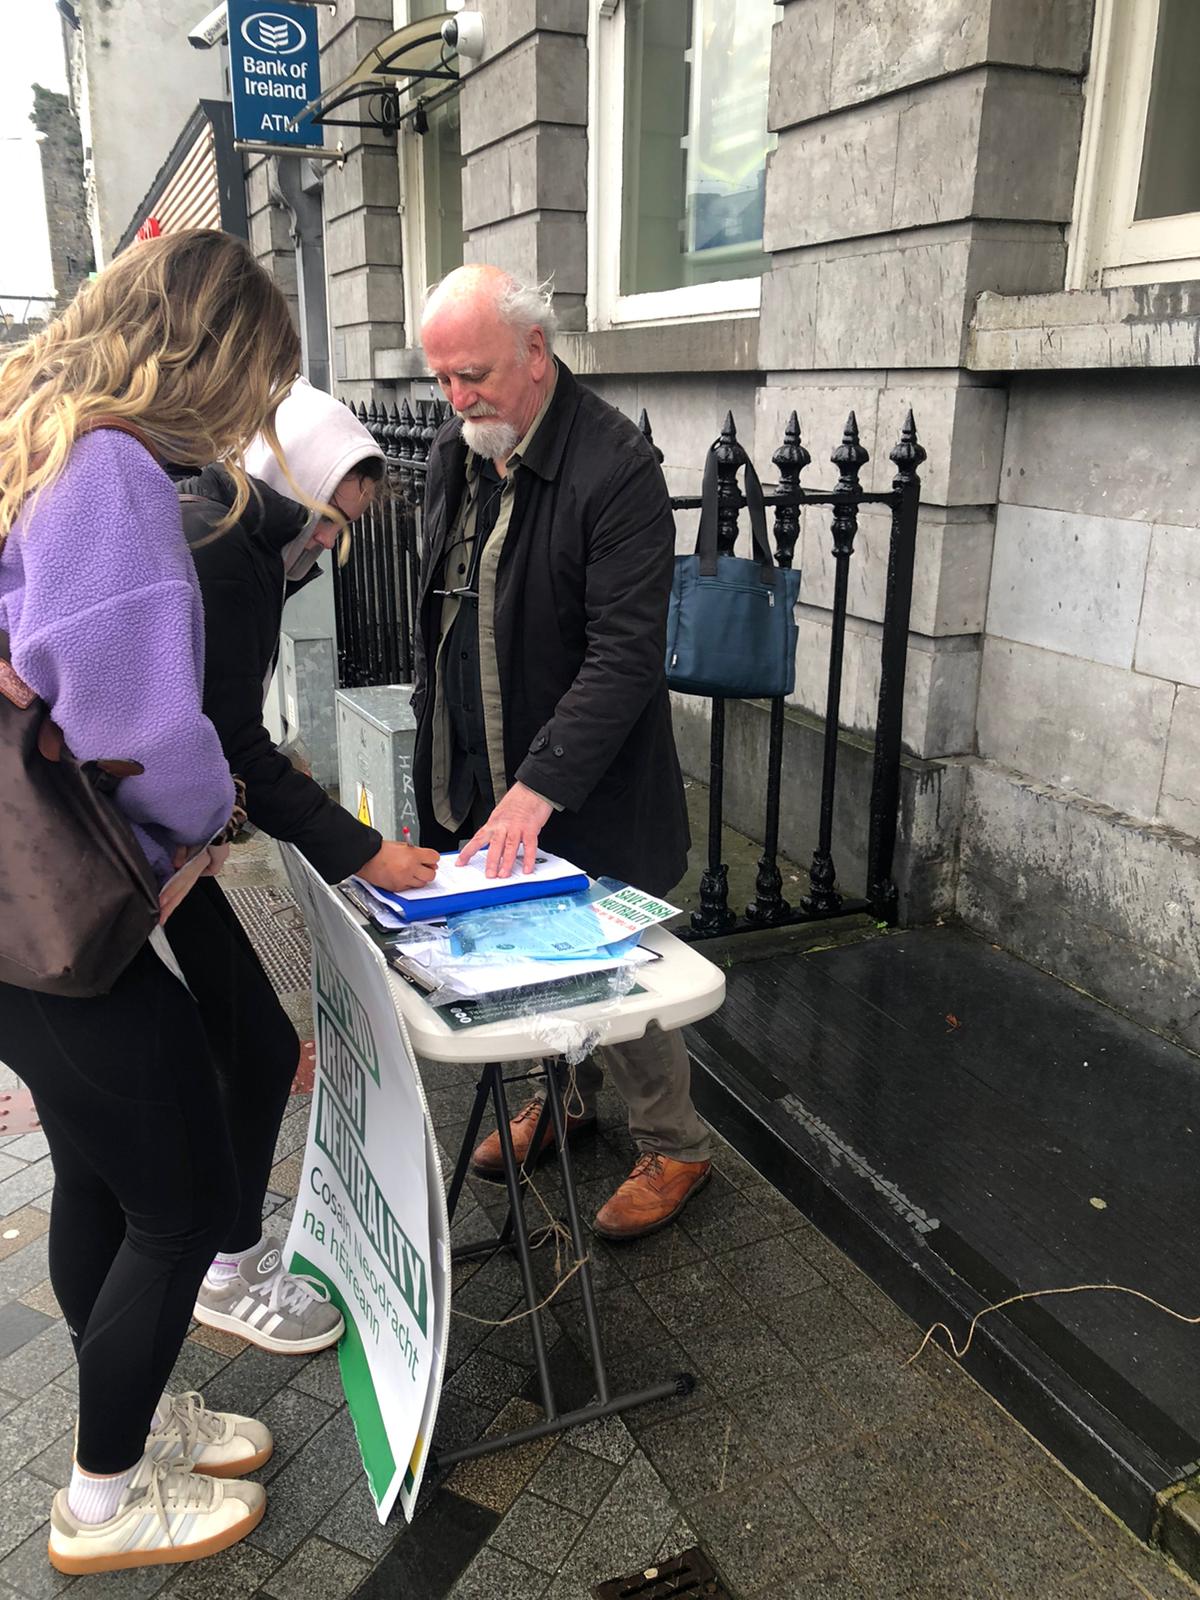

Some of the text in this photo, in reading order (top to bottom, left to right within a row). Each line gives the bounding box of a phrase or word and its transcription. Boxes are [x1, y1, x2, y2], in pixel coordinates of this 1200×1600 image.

[243, 56, 308, 79] Bank of
[244, 77, 307, 100] Ireland
[260, 113, 299, 133] ATM
[597, 898, 655, 925] NEUTRALITY
[615, 889, 647, 905] SAVE
[639, 900, 676, 918] IRISH
[320, 1010, 363, 1139] IRISH
[318, 1087, 425, 1318] NEUTRALITY
[303, 1209, 380, 1345] na hÉireann
[310, 1166, 419, 1382] Cosain Neodracht
